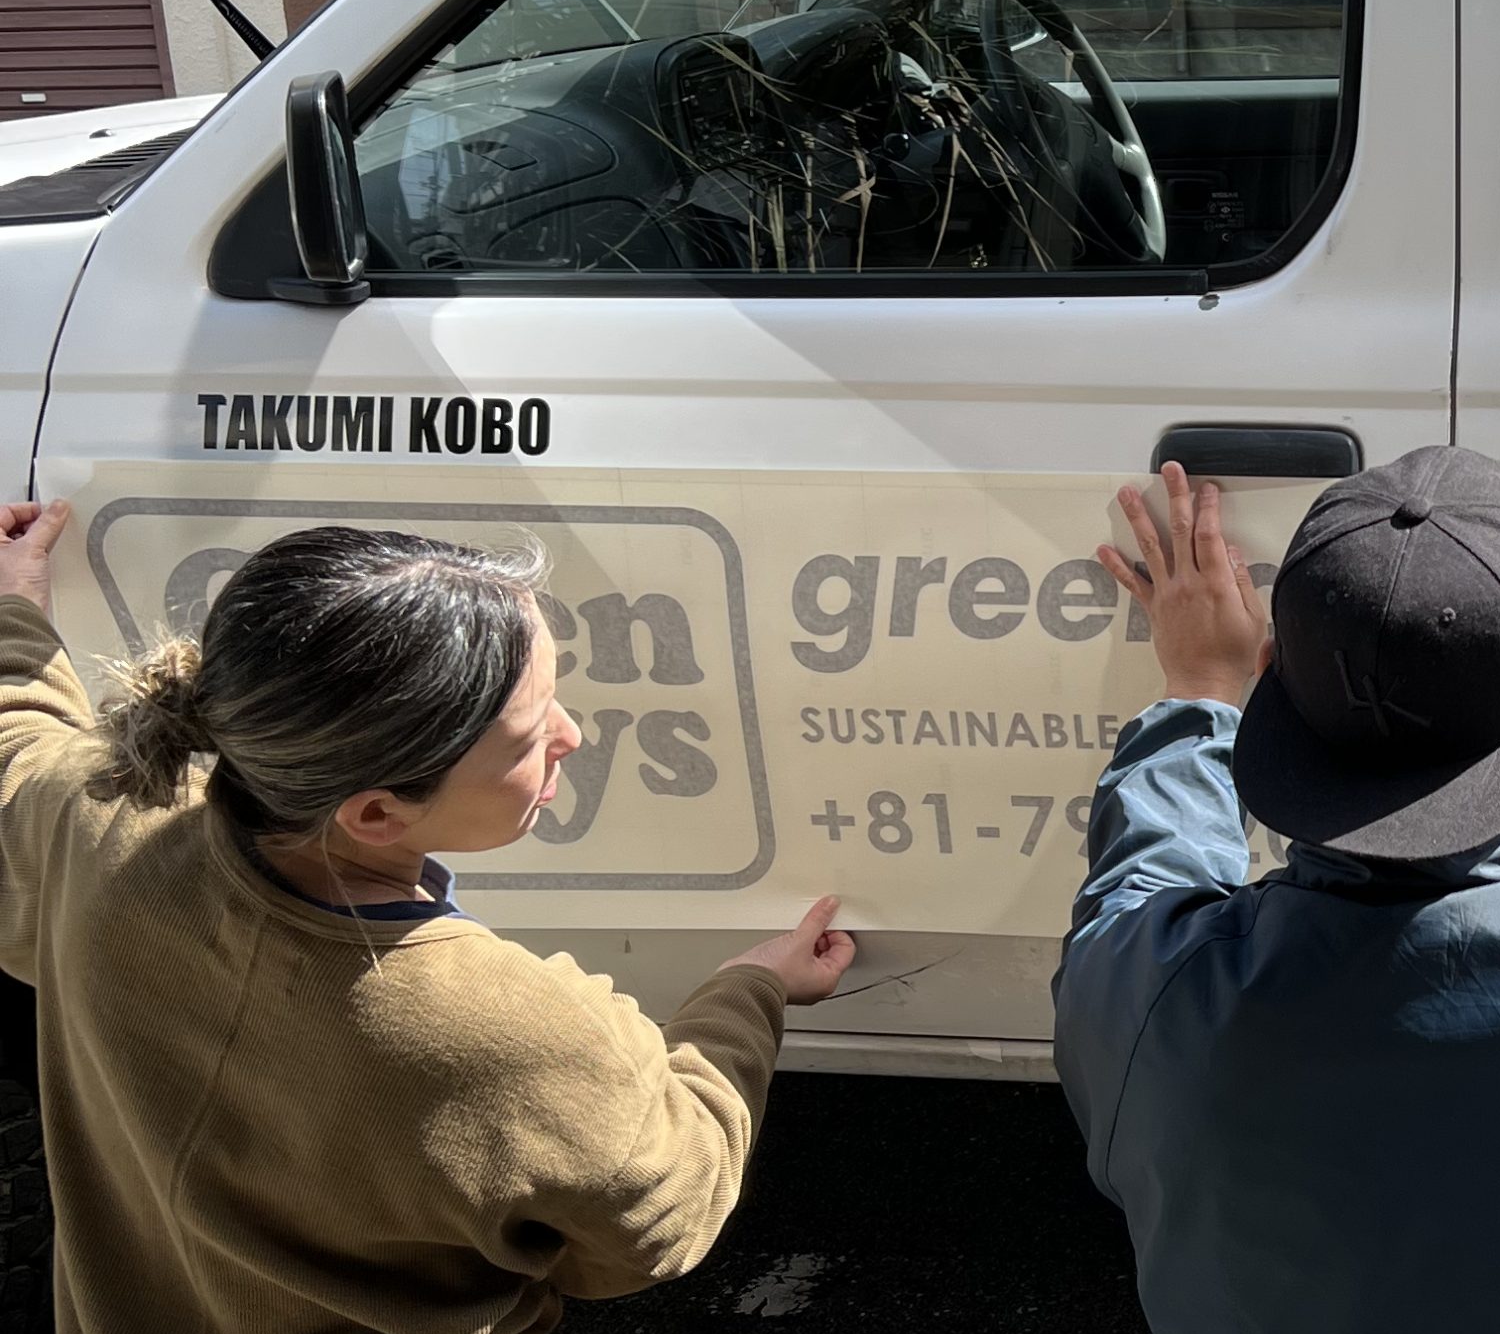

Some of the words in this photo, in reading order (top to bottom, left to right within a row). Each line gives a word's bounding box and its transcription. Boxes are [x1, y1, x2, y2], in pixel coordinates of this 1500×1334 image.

[198, 394, 394, 452] TAKUMI
[409, 396, 552, 455] KOBO
[800, 706, 1119, 750] SUSTAINABLE
